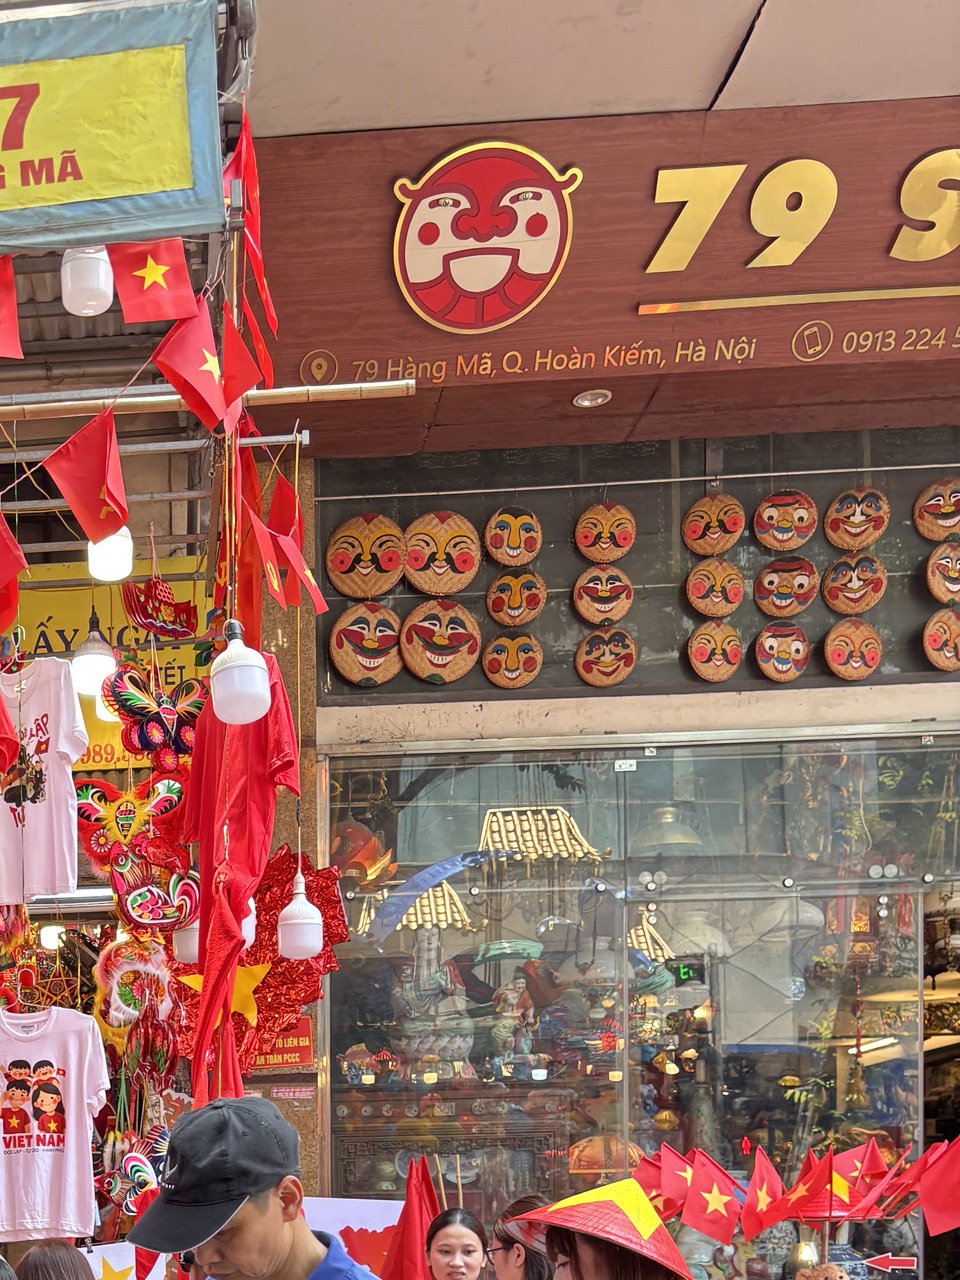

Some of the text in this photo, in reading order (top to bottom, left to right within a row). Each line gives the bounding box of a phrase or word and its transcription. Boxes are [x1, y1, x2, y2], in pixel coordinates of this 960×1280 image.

[19, 149, 84, 188] MÃ
[645, 158, 838, 274] 79
[842, 329, 895, 353] 0913
[901, 327, 947, 351] 224
[351, 336, 757, 384] 79 Hàng Mã, Q. Hoàn Kiếm, Hà Nội
[2, 1134, 65, 1149] VIET NAM
